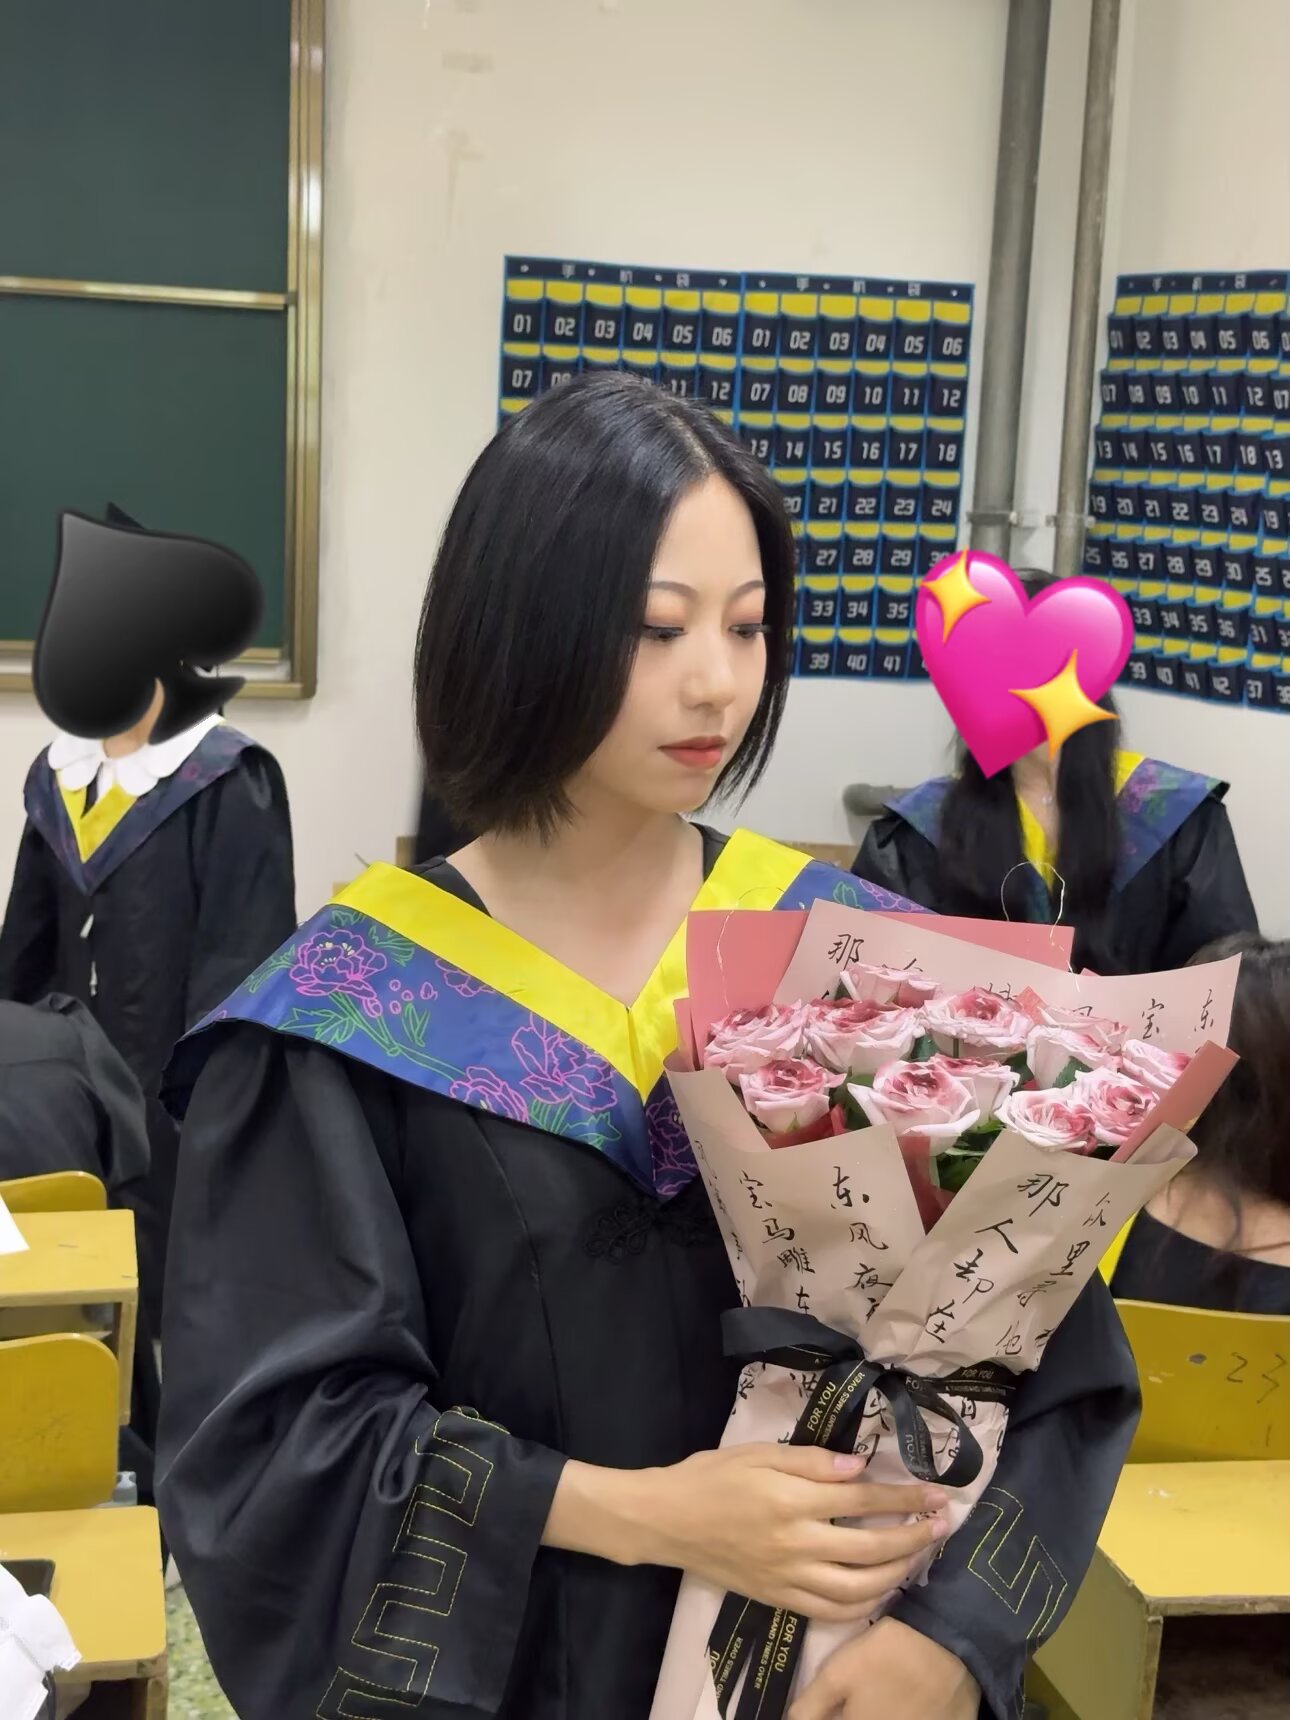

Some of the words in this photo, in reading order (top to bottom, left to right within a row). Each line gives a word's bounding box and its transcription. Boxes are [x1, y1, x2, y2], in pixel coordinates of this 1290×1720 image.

[513, 314, 532, 333] 01
[555, 317, 576, 336] 02
[595, 320, 615, 338] 03
[633, 322, 653, 341] 04
[672, 325, 693, 344] 05
[712, 327, 733, 346] 06
[752, 328, 771, 347] 01
[790, 331, 811, 349] 02
[829, 332, 849, 350] 03
[866, 334, 886, 352] 04
[904, 336, 924, 354] 05
[942, 337, 963, 355] 06
[1136, 331, 1151, 349] 02
[1163, 331, 1179, 350] 03
[1190, 331, 1207, 350] 04
[1219, 330, 1236, 350] 05
[1252, 331, 1270, 350] 06
[512, 369, 533, 388] 07
[671, 380, 686, 397] 11
[712, 381, 730, 399] 12
[751, 383, 771, 401] 07
[788, 385, 808, 403] 08
[826, 385, 847, 403] 09
[864, 387, 883, 404] 10
[903, 388, 920, 405] 11
[942, 389, 961, 407] 12
[1102, 385, 1116, 402] 07
[1155, 386, 1172, 404] 09
[1182, 386, 1199, 405] 10
[1212, 386, 1227, 406] 11
[1247, 387, 1264, 406] 12
[1273, 390, 1290, 409] 07
[751, 440, 769, 458] 13
[786, 441, 804, 459] 14
[824, 441, 843, 459] 15
[862, 442, 880, 460] 16
[899, 443, 918, 461] 17
[938, 444, 957, 462] 18
[1097, 441, 1113, 459] 13
[1122, 442, 1138, 461] 14
[1151, 442, 1167, 461] 15
[1177, 444, 1195, 463] 16
[1206, 445, 1222, 464] 17
[1240, 445, 1257, 466] 18
[1265, 449, 1283, 469] 13
[818, 497, 837, 514] 21
[855, 498, 876, 514] 22
[894, 499, 915, 515] 23
[931, 500, 952, 516] 24
[1091, 495, 1107, 513] 19
[1117, 498, 1133, 515] 20
[1145, 499, 1160, 518] 21
[1172, 502, 1189, 521] 22
[1201, 504, 1220, 523] 23
[1230, 506, 1248, 526] 24
[1264, 509, 1280, 529] 19
[816, 550, 837, 566] 27
[852, 549, 874, 566] 28
[890, 550, 912, 566] 29
[1111, 551, 1129, 569] 26
[1138, 552, 1155, 571] 27
[1166, 556, 1185, 574] 28
[1194, 558, 1213, 577] 29
[1225, 561, 1242, 581] 30
[1255, 567, 1272, 586] 25
[811, 601, 834, 617] 33
[847, 601, 869, 617] 34
[886, 603, 909, 619] 35
[1133, 608, 1152, 625] 33
[1161, 611, 1180, 629] 34
[1189, 614, 1208, 632] 35
[1217, 618, 1236, 639] 36
[1251, 624, 1268, 644] 31
[810, 653, 830, 669] 39
[847, 654, 867, 671] 40
[884, 655, 900, 672] 41
[1129, 661, 1147, 680] 39
[1156, 667, 1173, 685] 40
[1185, 671, 1200, 690] 41
[1212, 676, 1231, 695] 42
[1247, 679, 1263, 699] 37
[828, 933, 864, 971] 那
[1142, 998, 1165, 1040] 宝
[1194, 988, 1214, 1032] 东
[833, 1391, 850, 1414] TIMES
[847, 1372, 866, 1392] OVER
[807, 1407, 823, 1432] FOR
[818, 1381, 836, 1406] YOU
[783, 1615, 798, 1643] FOR
[710, 1650, 720, 1669] OU
[720, 1659, 734, 1683] TIMES
[730, 1636, 744, 1660] OVER
[761, 1641, 773, 1665] TIMES
[774, 1646, 790, 1672] YOU
[754, 1666, 765, 1689] OVER
